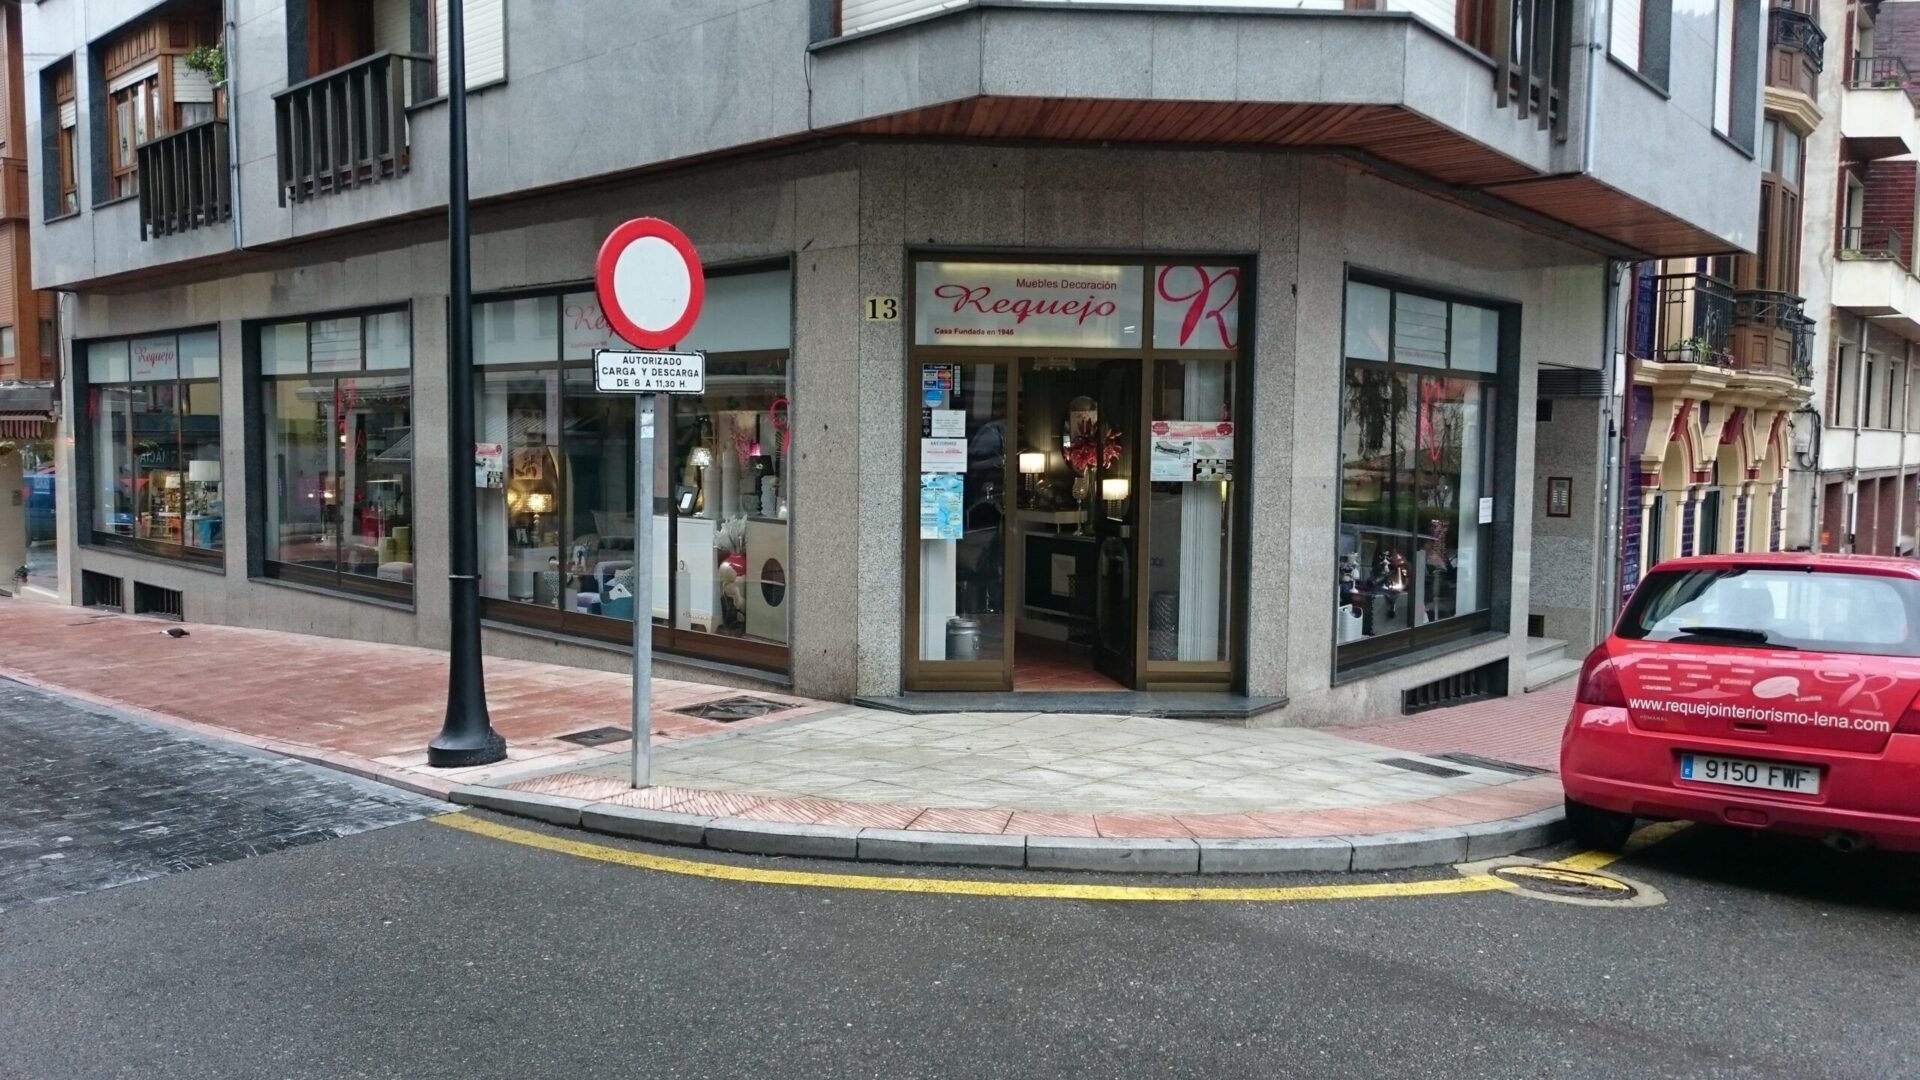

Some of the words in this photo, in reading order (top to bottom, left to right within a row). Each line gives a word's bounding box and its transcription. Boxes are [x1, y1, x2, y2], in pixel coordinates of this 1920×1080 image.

[1016, 278, 1058, 289] Muebles
[1060, 280, 1117, 290] Decoración
[868, 298, 898, 320] 13
[934, 284, 1116, 325] Requejo
[622, 356, 682, 366] AUTORIZADO
[601, 367, 636, 376] CARGA
[641, 368, 647, 376] Y
[651, 368, 699, 377] DESCARGA
[616, 379, 629, 387] DE
[634, 379, 641, 387] 8
[645, 380, 652, 388] A
[1629, 697, 1890, 732] www.requejointeriorismo-lena.com
[1705, 759, 1758, 783] 9150
[1768, 766, 1811, 789] FWF
